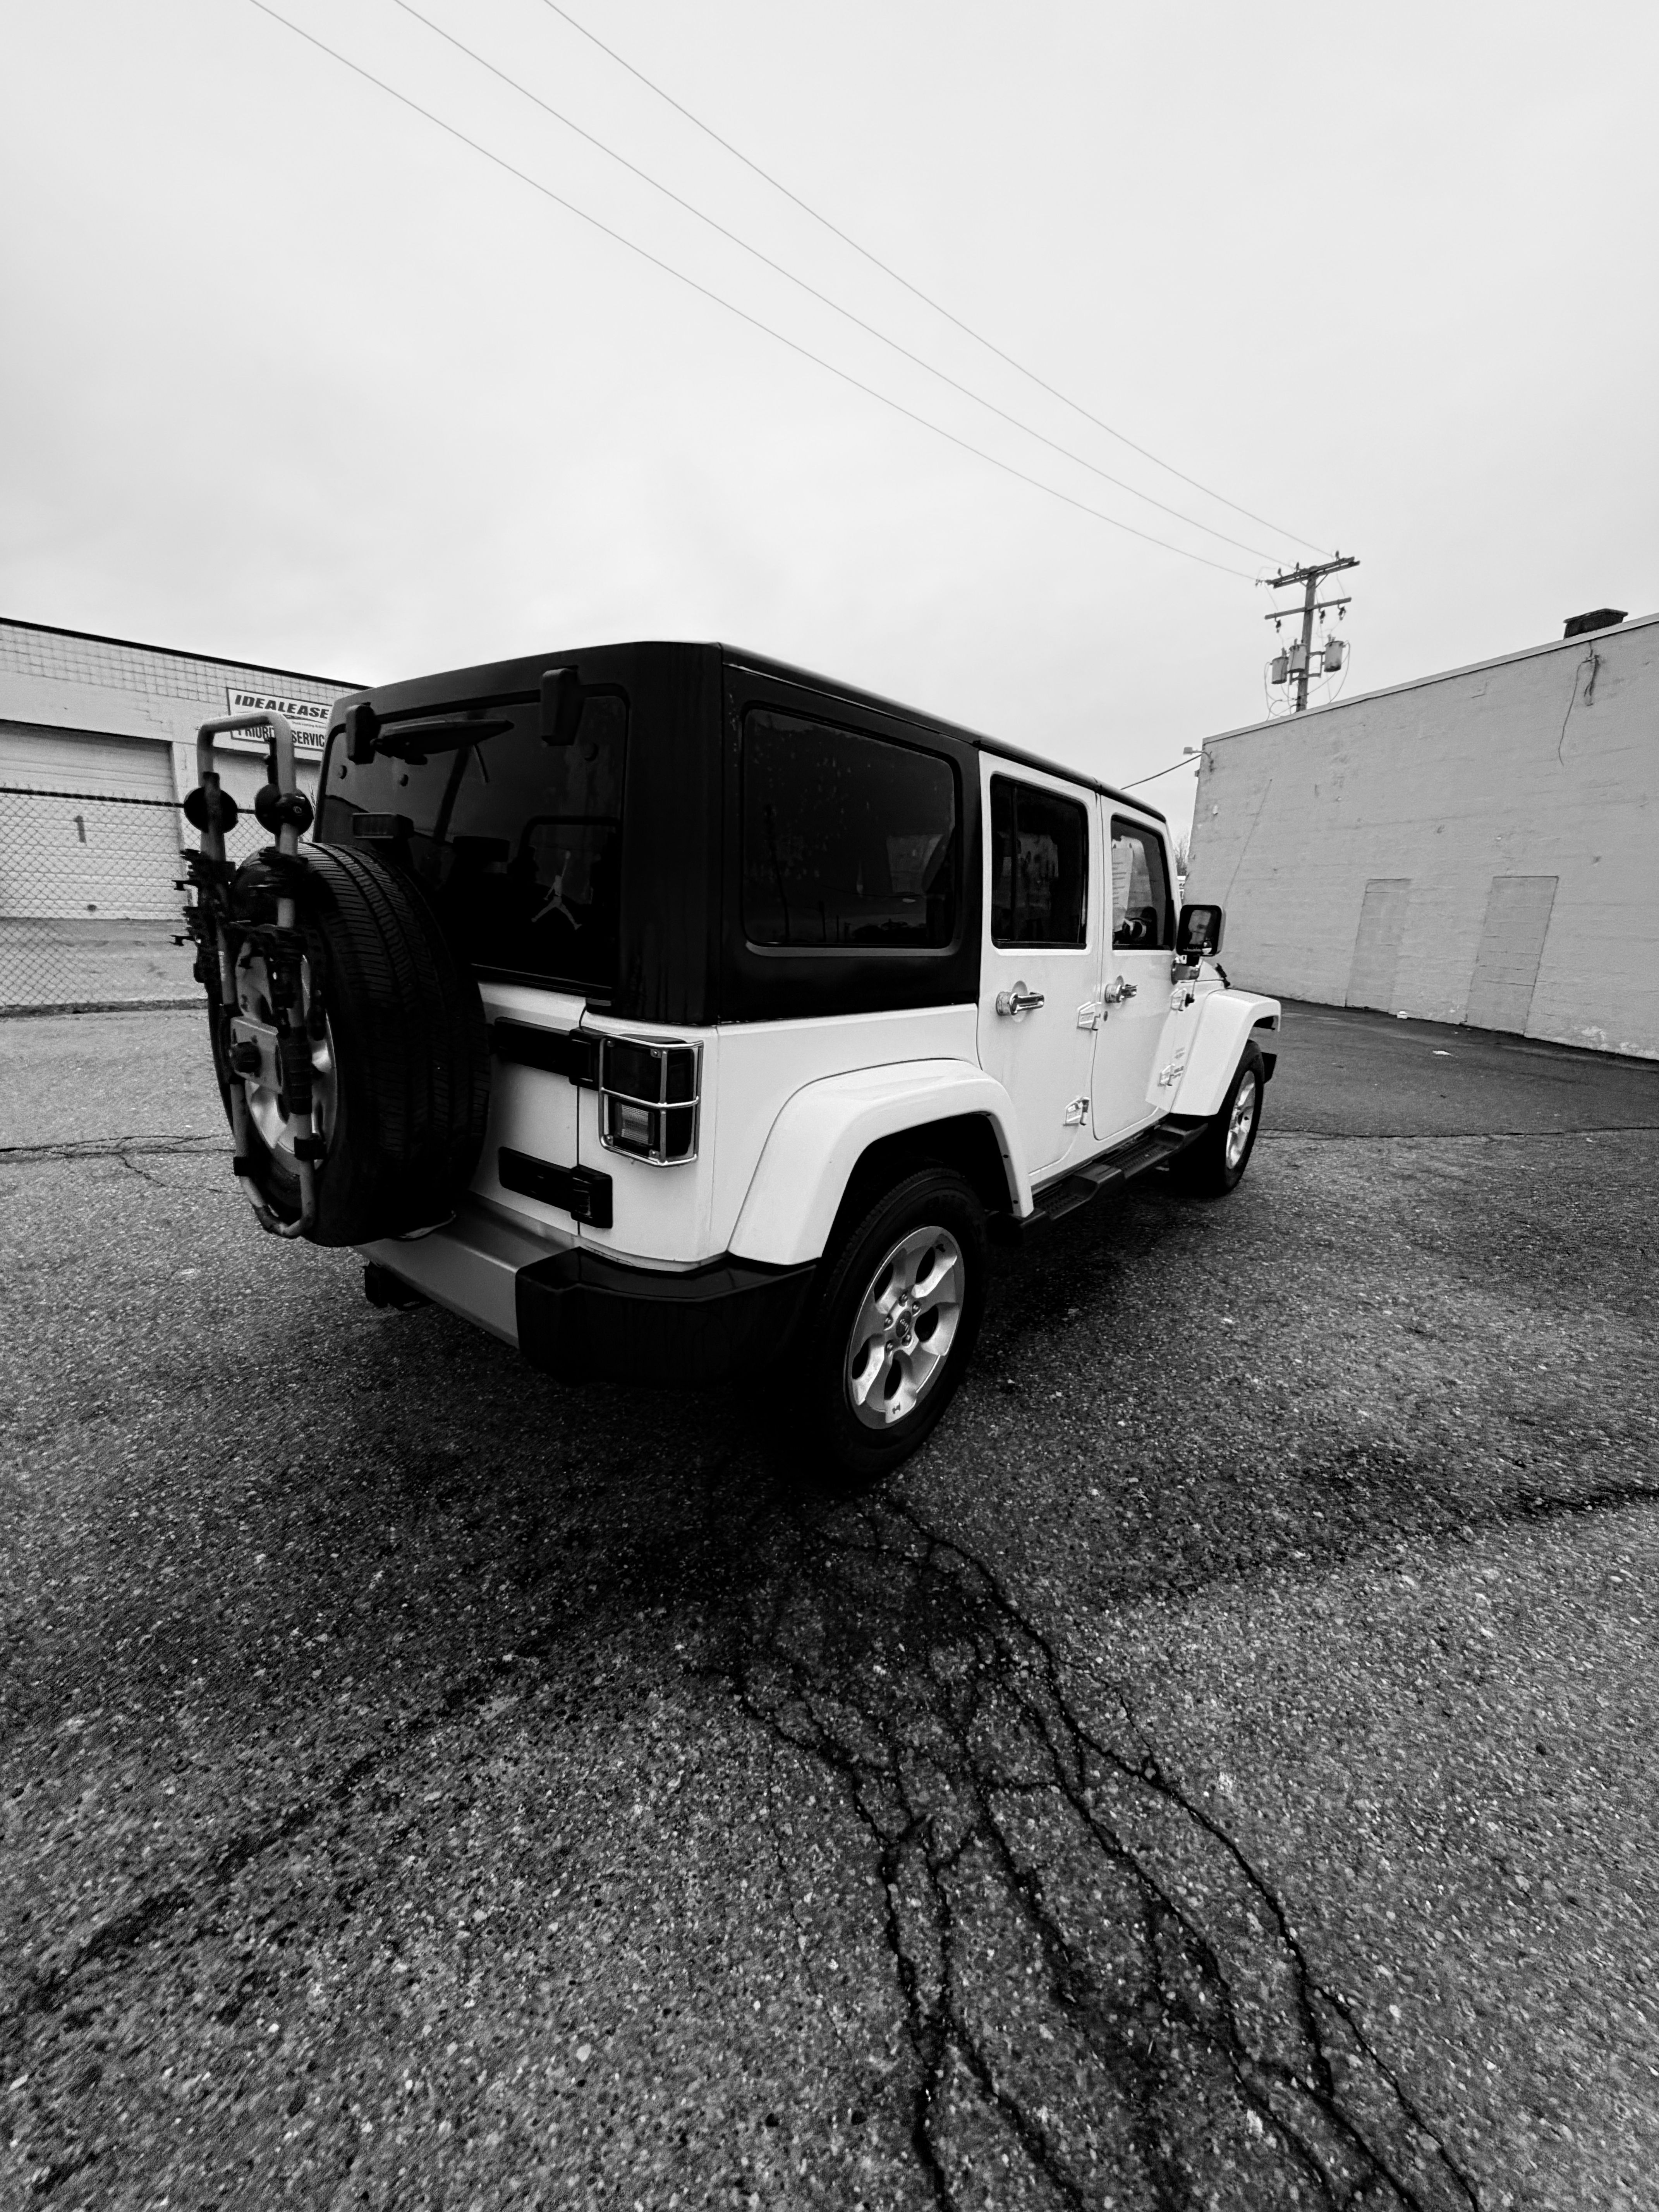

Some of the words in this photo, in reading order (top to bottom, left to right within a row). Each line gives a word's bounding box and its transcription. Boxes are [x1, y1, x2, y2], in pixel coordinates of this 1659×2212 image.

[235, 695, 329, 719] IDEALEASE
[291, 730, 325, 747] SERVIC
[73, 816, 86, 843] 1
